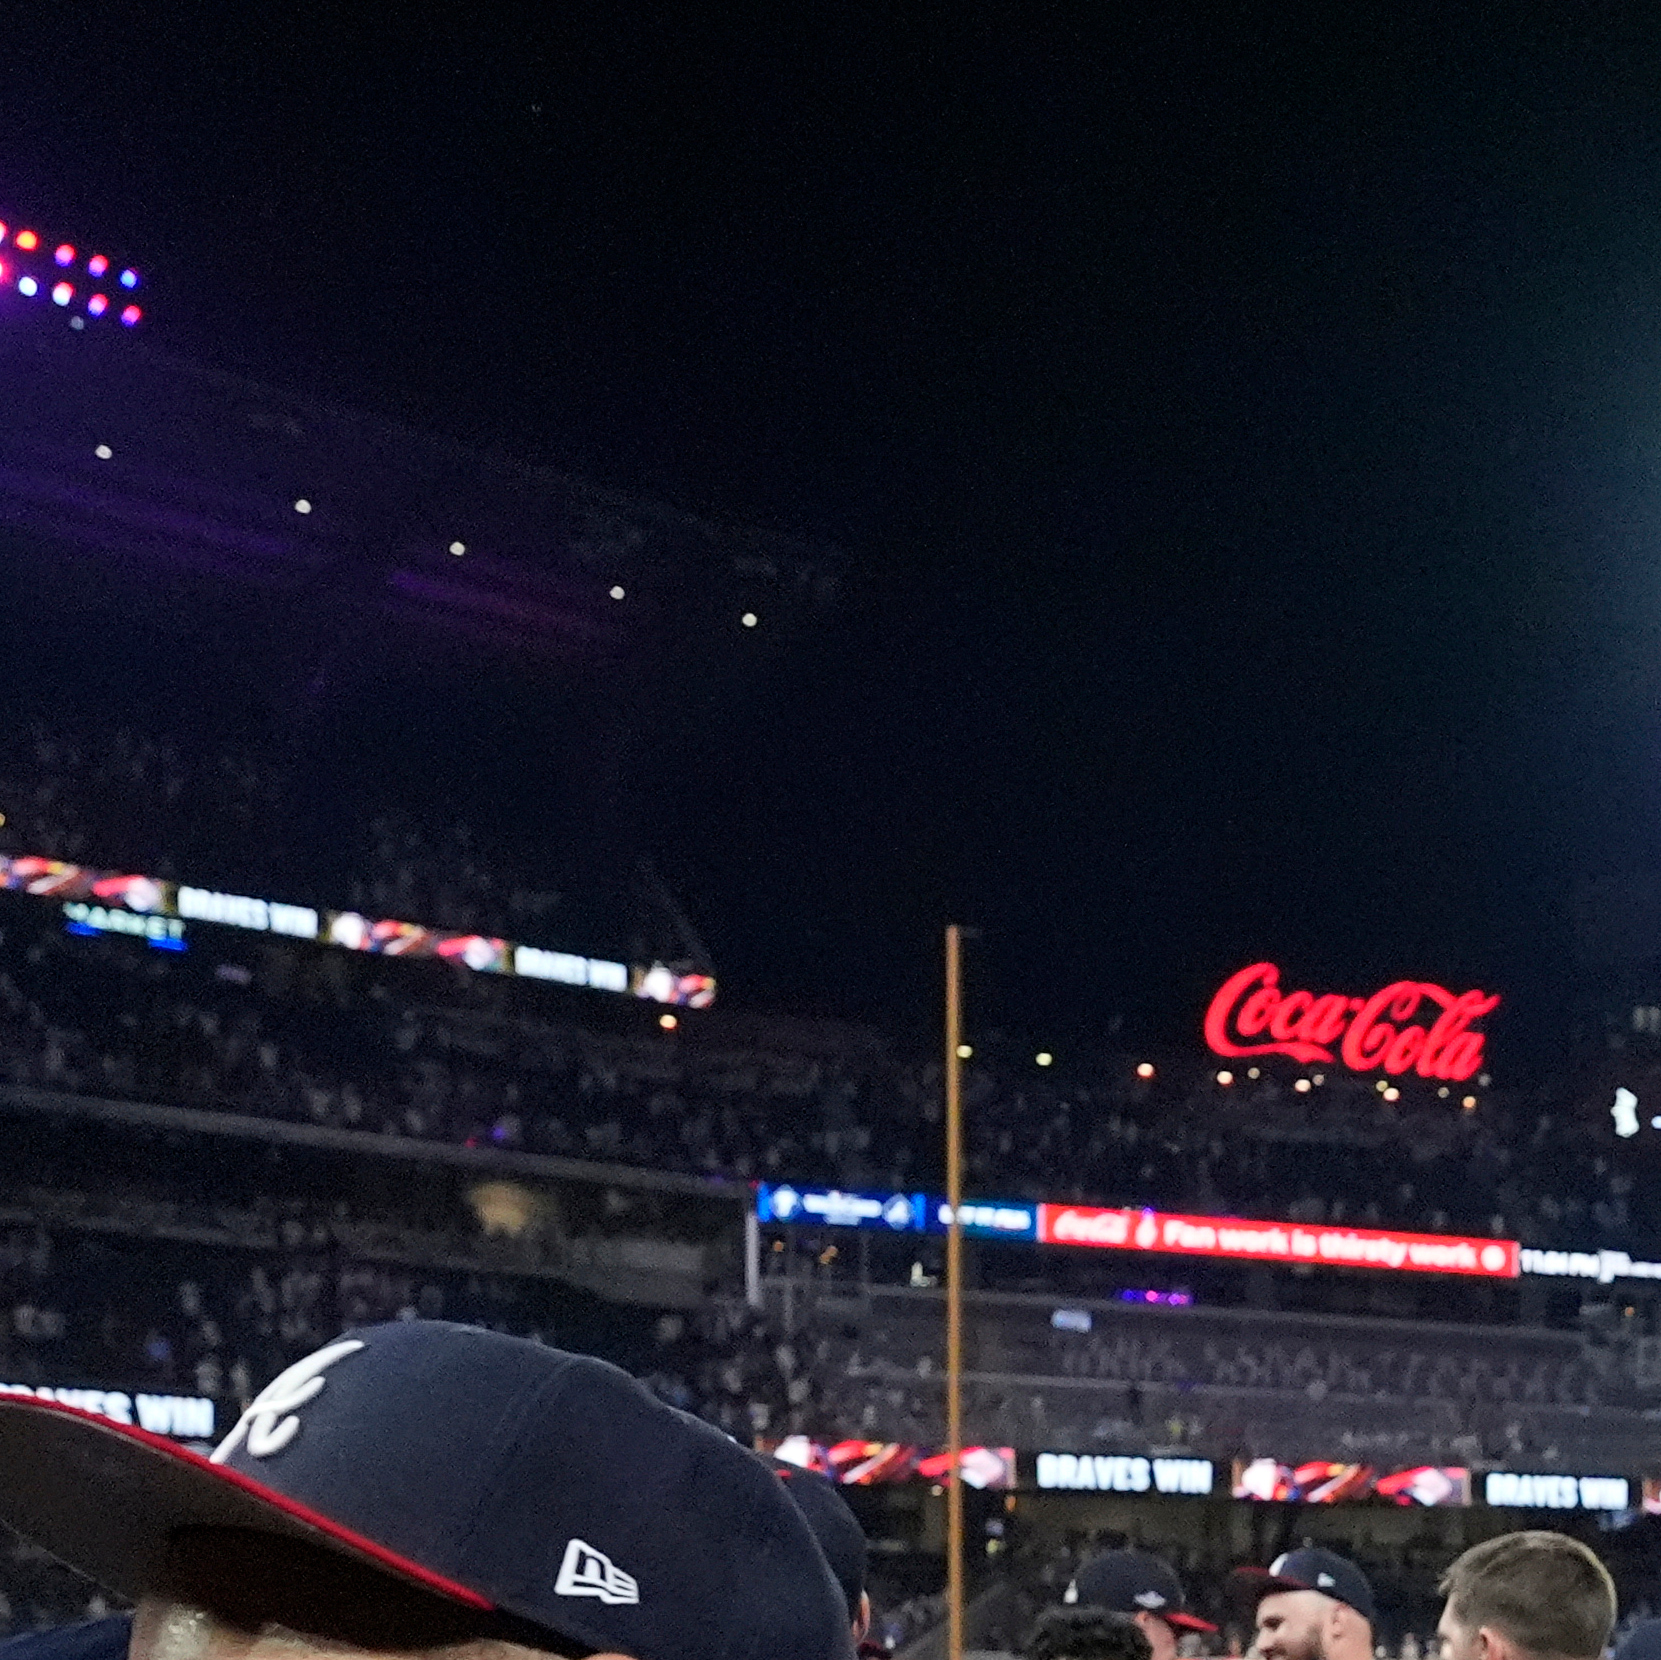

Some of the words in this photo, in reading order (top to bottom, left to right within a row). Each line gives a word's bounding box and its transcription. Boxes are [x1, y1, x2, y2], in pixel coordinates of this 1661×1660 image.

[1204, 962, 1502, 1081] Coca-Cola
[1218, 1228, 1289, 1255] work
[1408, 1243, 1477, 1270] work
[1037, 1453, 1150, 1492] BRAVES
[1152, 1457, 1213, 1495] WIN
